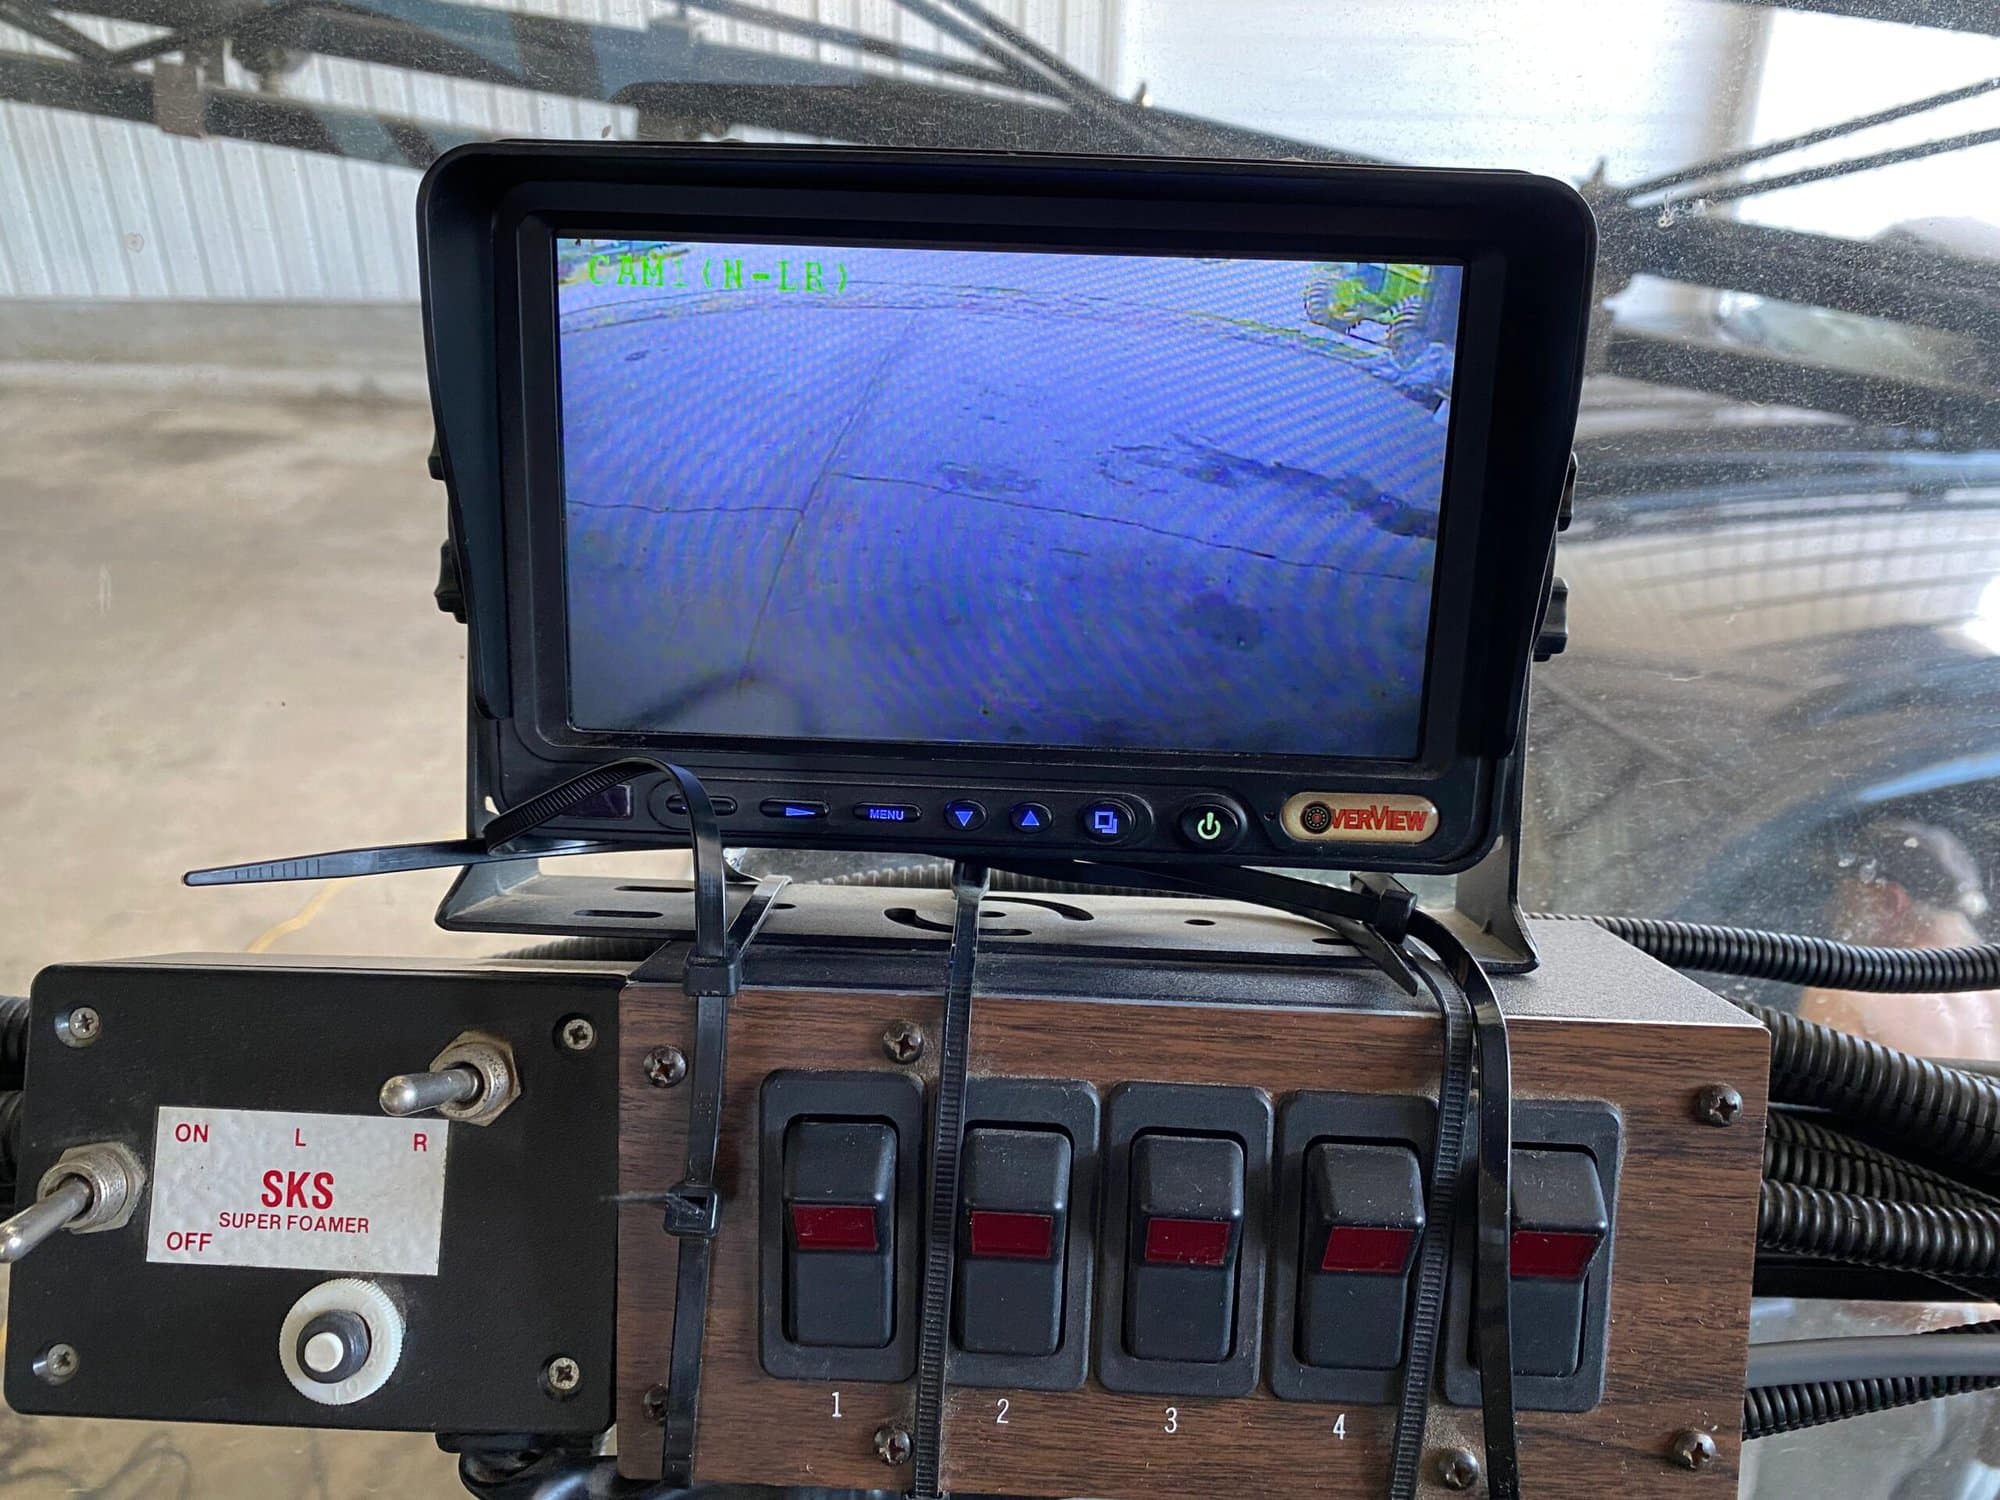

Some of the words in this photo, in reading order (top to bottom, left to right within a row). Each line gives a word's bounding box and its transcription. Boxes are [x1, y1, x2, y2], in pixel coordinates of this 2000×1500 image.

[869, 808, 904, 821] MENU
[175, 1123, 209, 1143] ON
[295, 1128, 306, 1147] L
[413, 1133, 427, 1152] R
[260, 1169, 335, 1210] SKS
[219, 1212, 281, 1230] SUPER
[287, 1214, 369, 1234] FOAMER
[166, 1231, 213, 1251] OFF
[831, 1391, 842, 1418] 1
[996, 1398, 1010, 1424] 2
[1164, 1406, 1178, 1434] 3
[1332, 1413, 1347, 1440] 4
